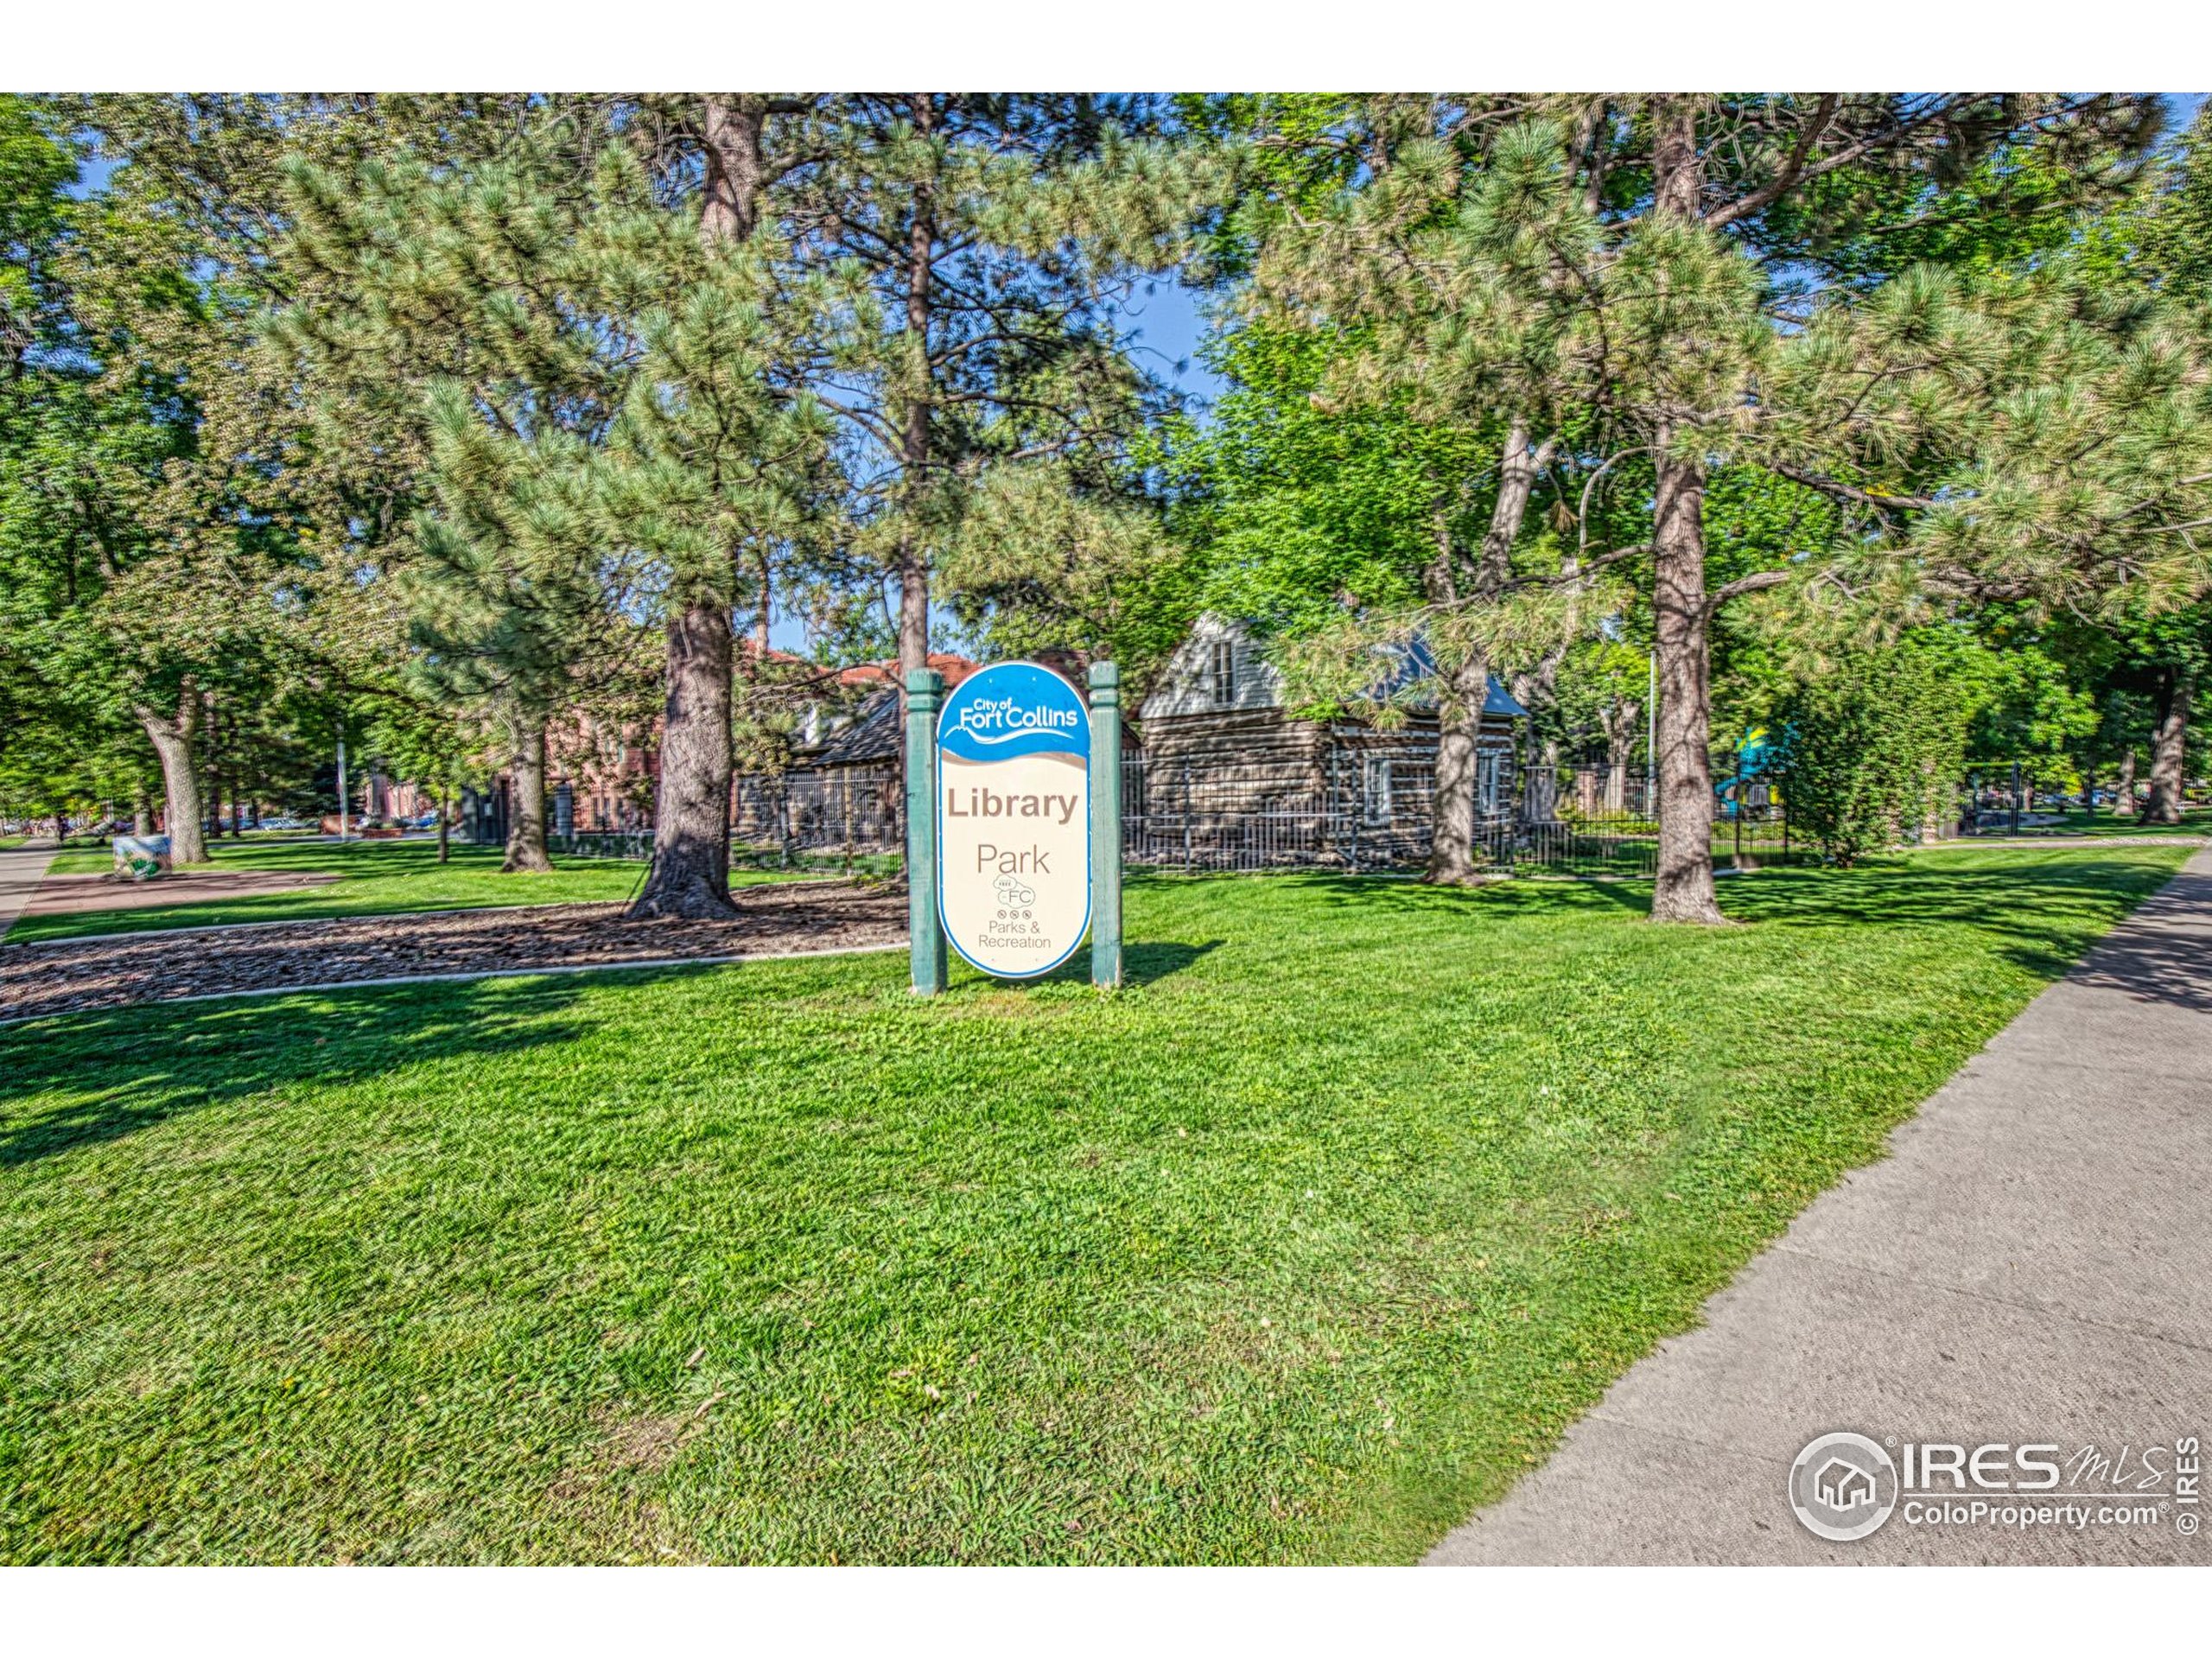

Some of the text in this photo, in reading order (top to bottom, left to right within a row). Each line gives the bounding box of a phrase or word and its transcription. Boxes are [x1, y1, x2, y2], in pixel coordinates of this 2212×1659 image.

[974, 697, 1013, 713] City of
[960, 705, 1078, 728] Fort Collins
[948, 788, 1078, 825] Library
[977, 844, 1050, 874] Park
[1008, 890, 1032, 903] FC
[989, 920, 1041, 934] Parks &
[978, 935, 1051, 949] Recreation
